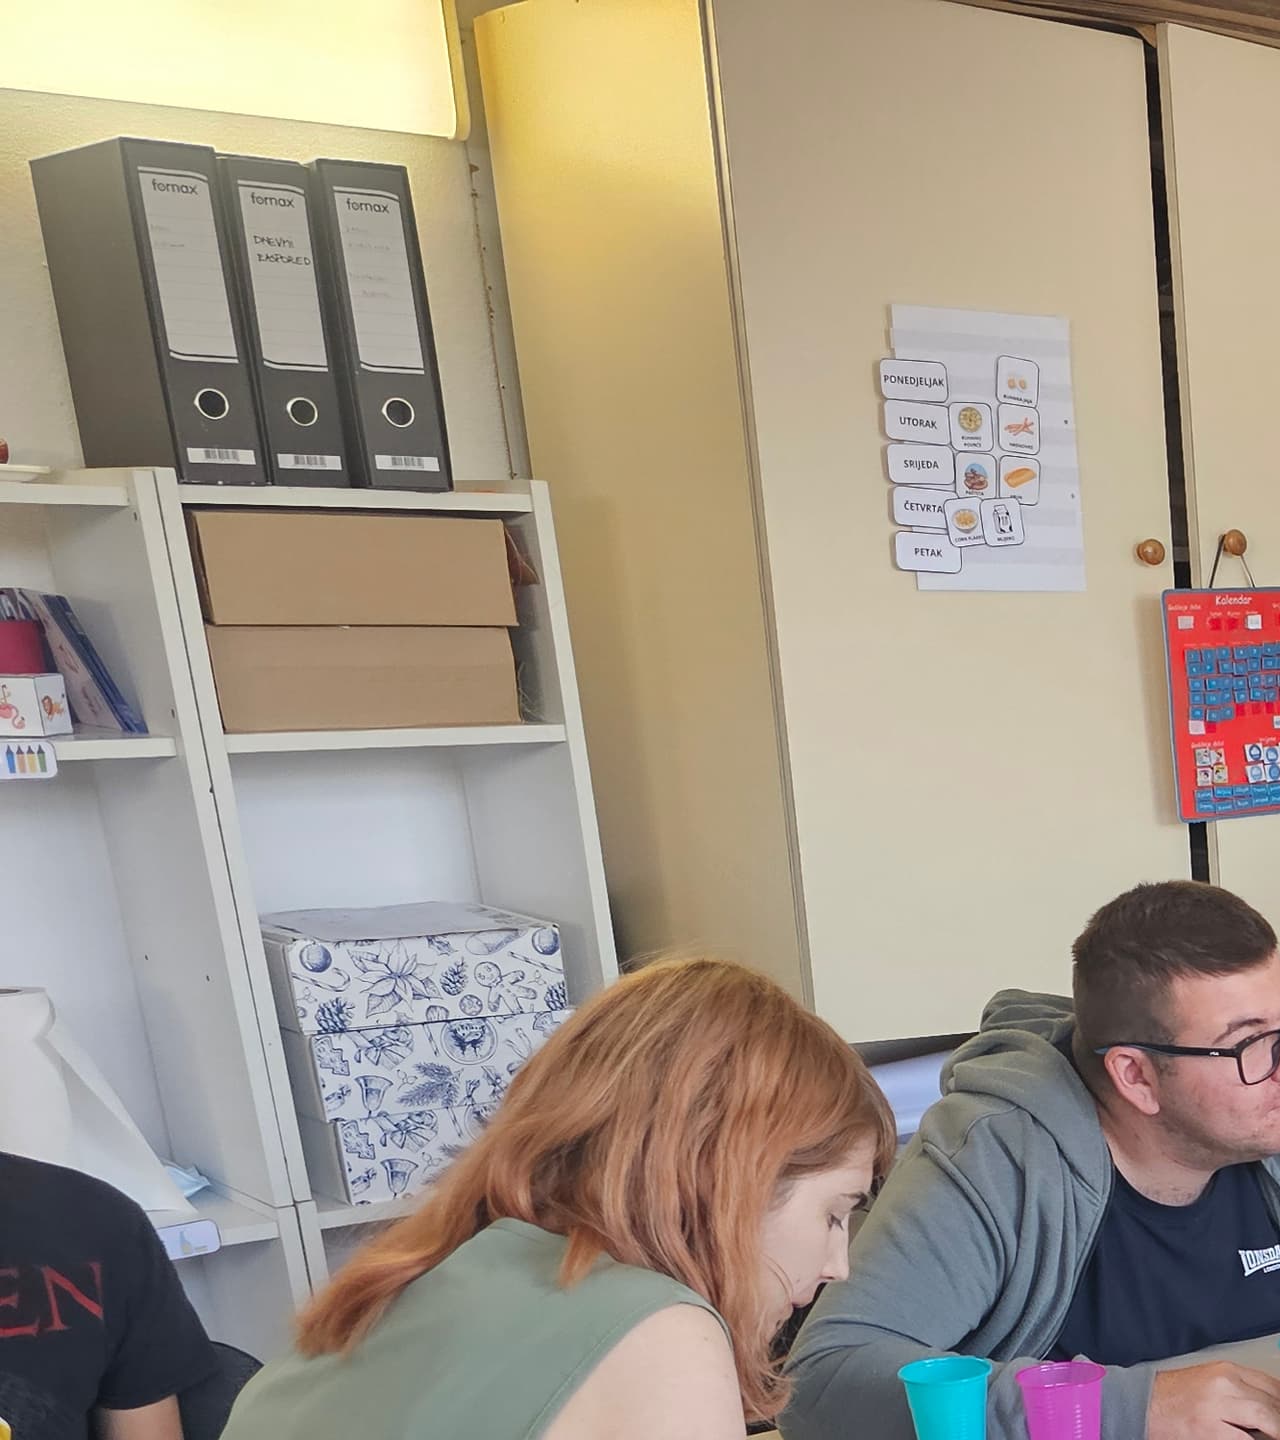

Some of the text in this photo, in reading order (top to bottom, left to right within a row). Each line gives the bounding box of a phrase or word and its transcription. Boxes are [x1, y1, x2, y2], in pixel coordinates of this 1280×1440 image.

[151, 178, 199, 196] fornax
[250, 192, 296, 209] fornax
[346, 198, 391, 214] fornax
[883, 374, 945, 389] PONEDJELJAK
[899, 416, 938, 430] UTORAK
[903, 459, 940, 471] SRIJEDA
[903, 500, 944, 514] ČETVRTA
[914, 547, 943, 558] PETAK
